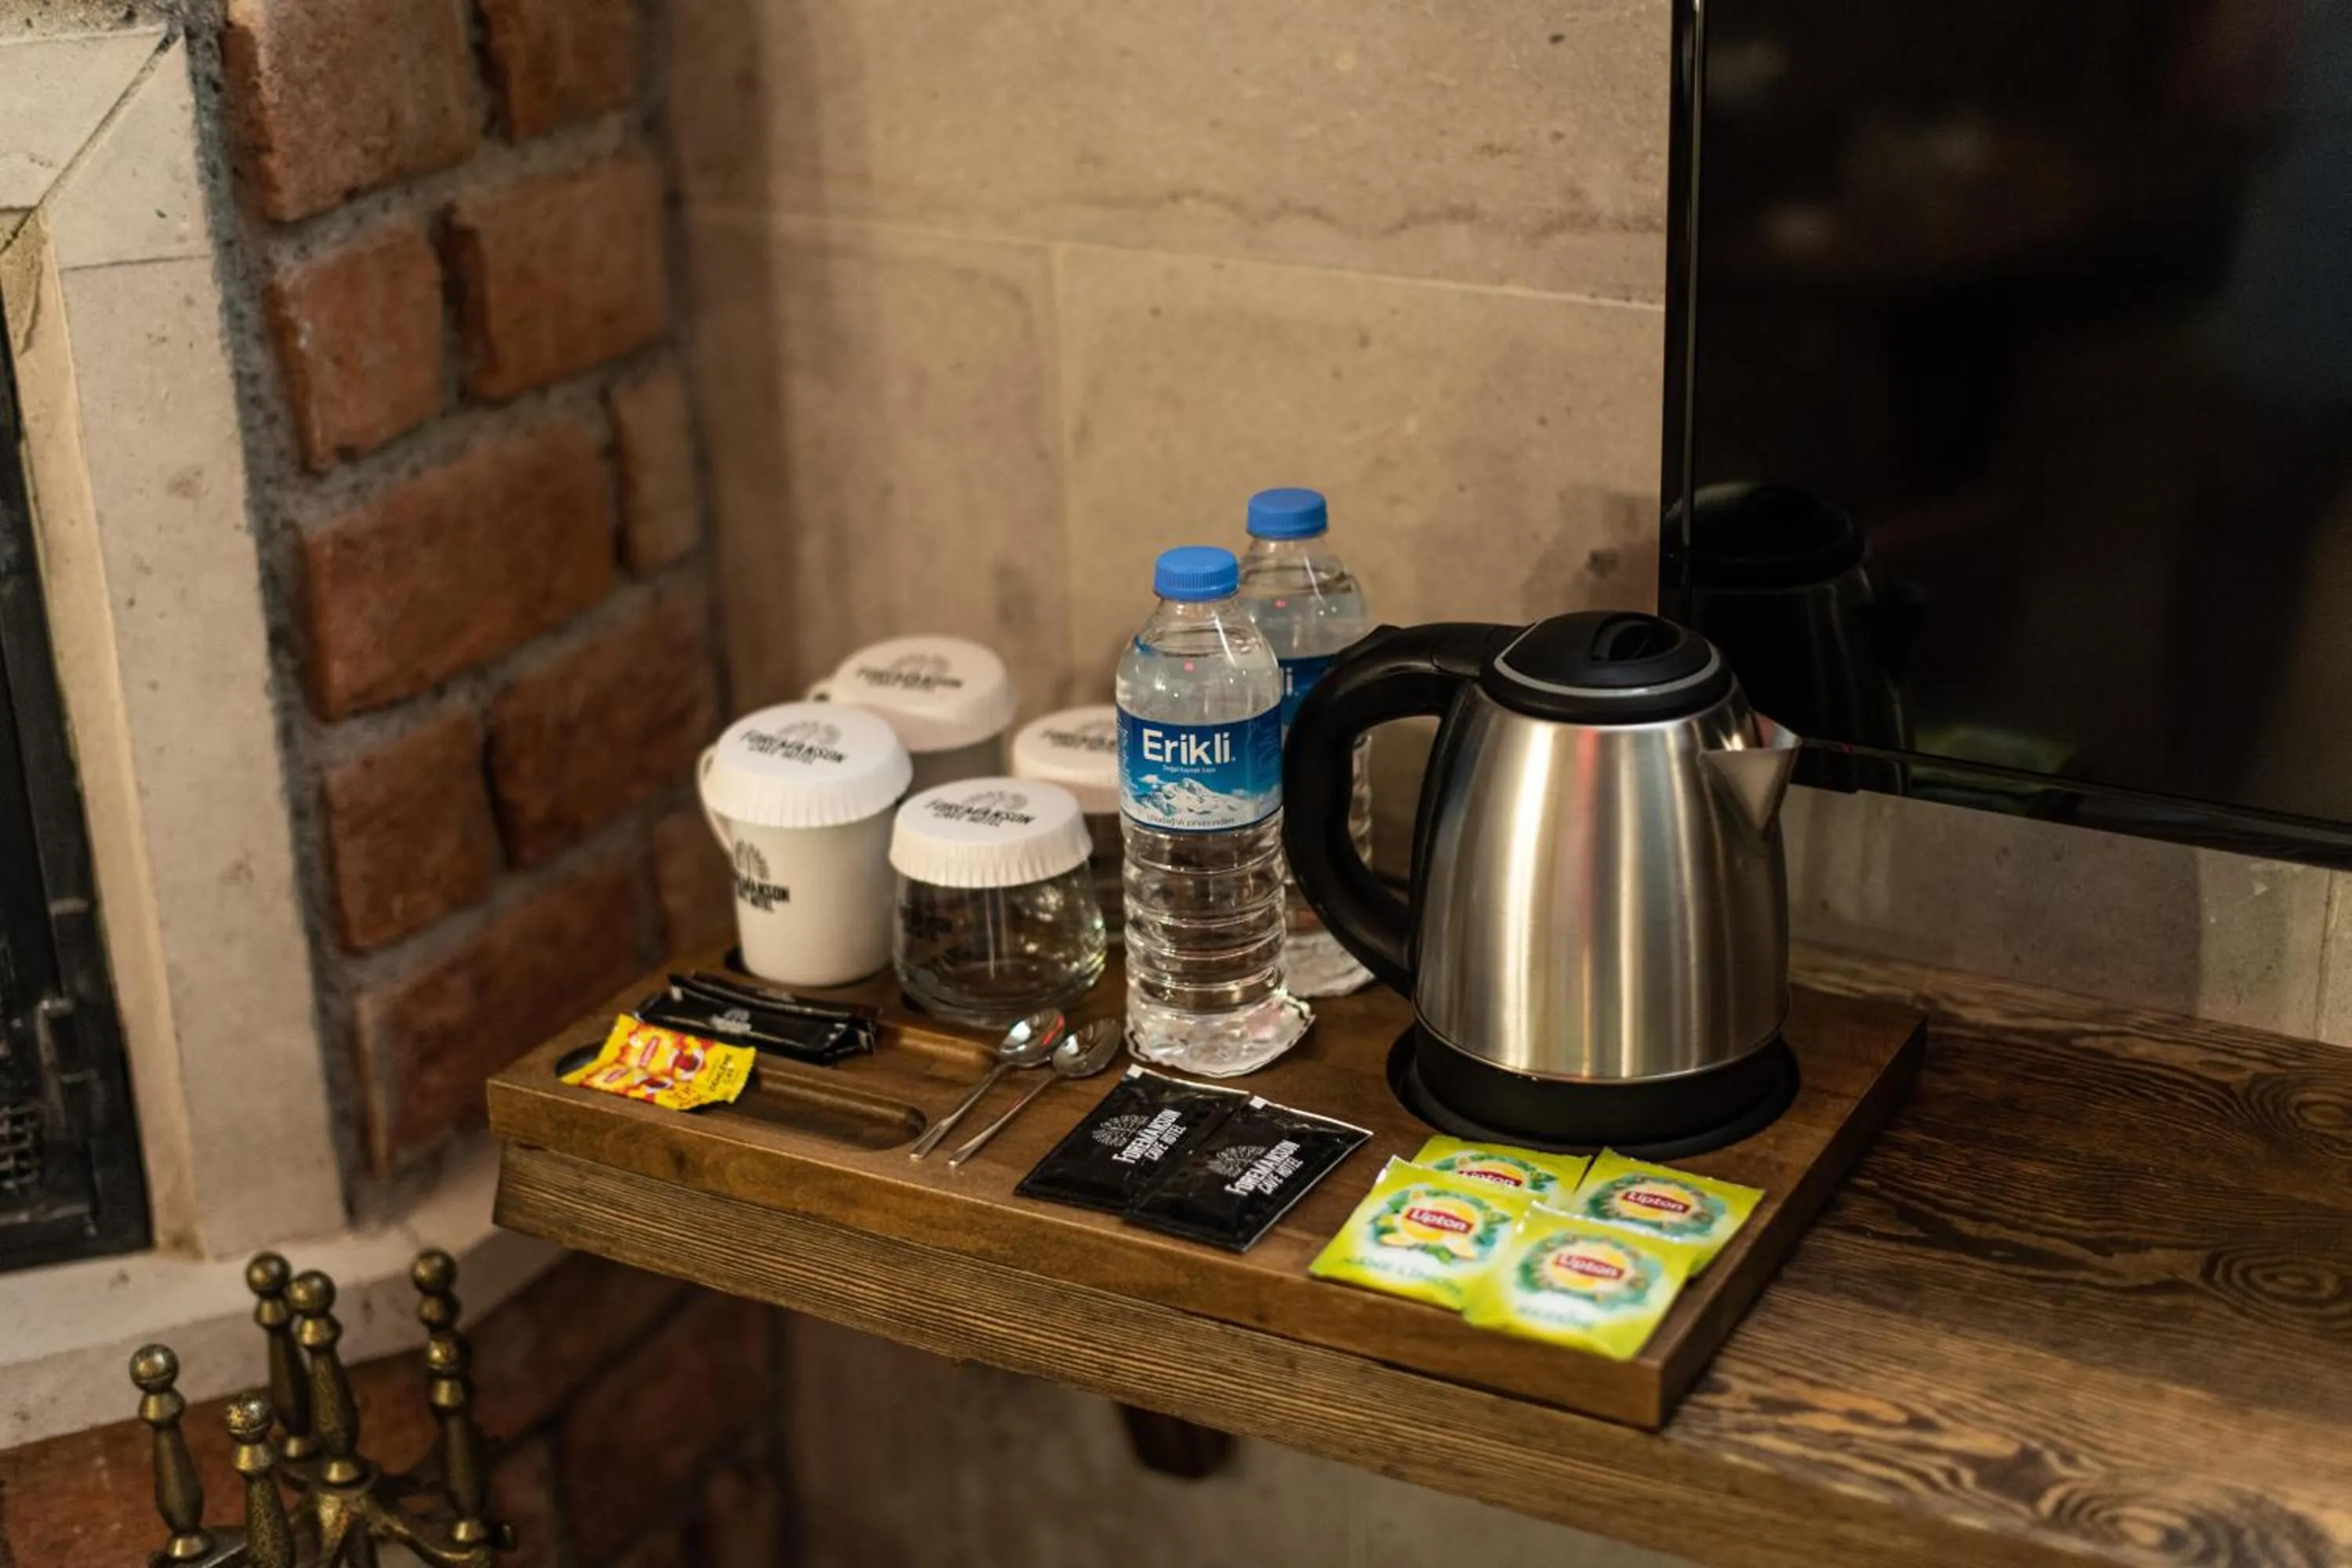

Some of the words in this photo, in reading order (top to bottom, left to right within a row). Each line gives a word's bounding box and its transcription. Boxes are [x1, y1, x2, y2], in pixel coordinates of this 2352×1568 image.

[1142, 728, 1230, 765] Erikli
[1628, 1191, 1686, 1213] Lipton
[1412, 1210, 1468, 1231] Lipton
[1560, 1254, 1620, 1279] Lipton
